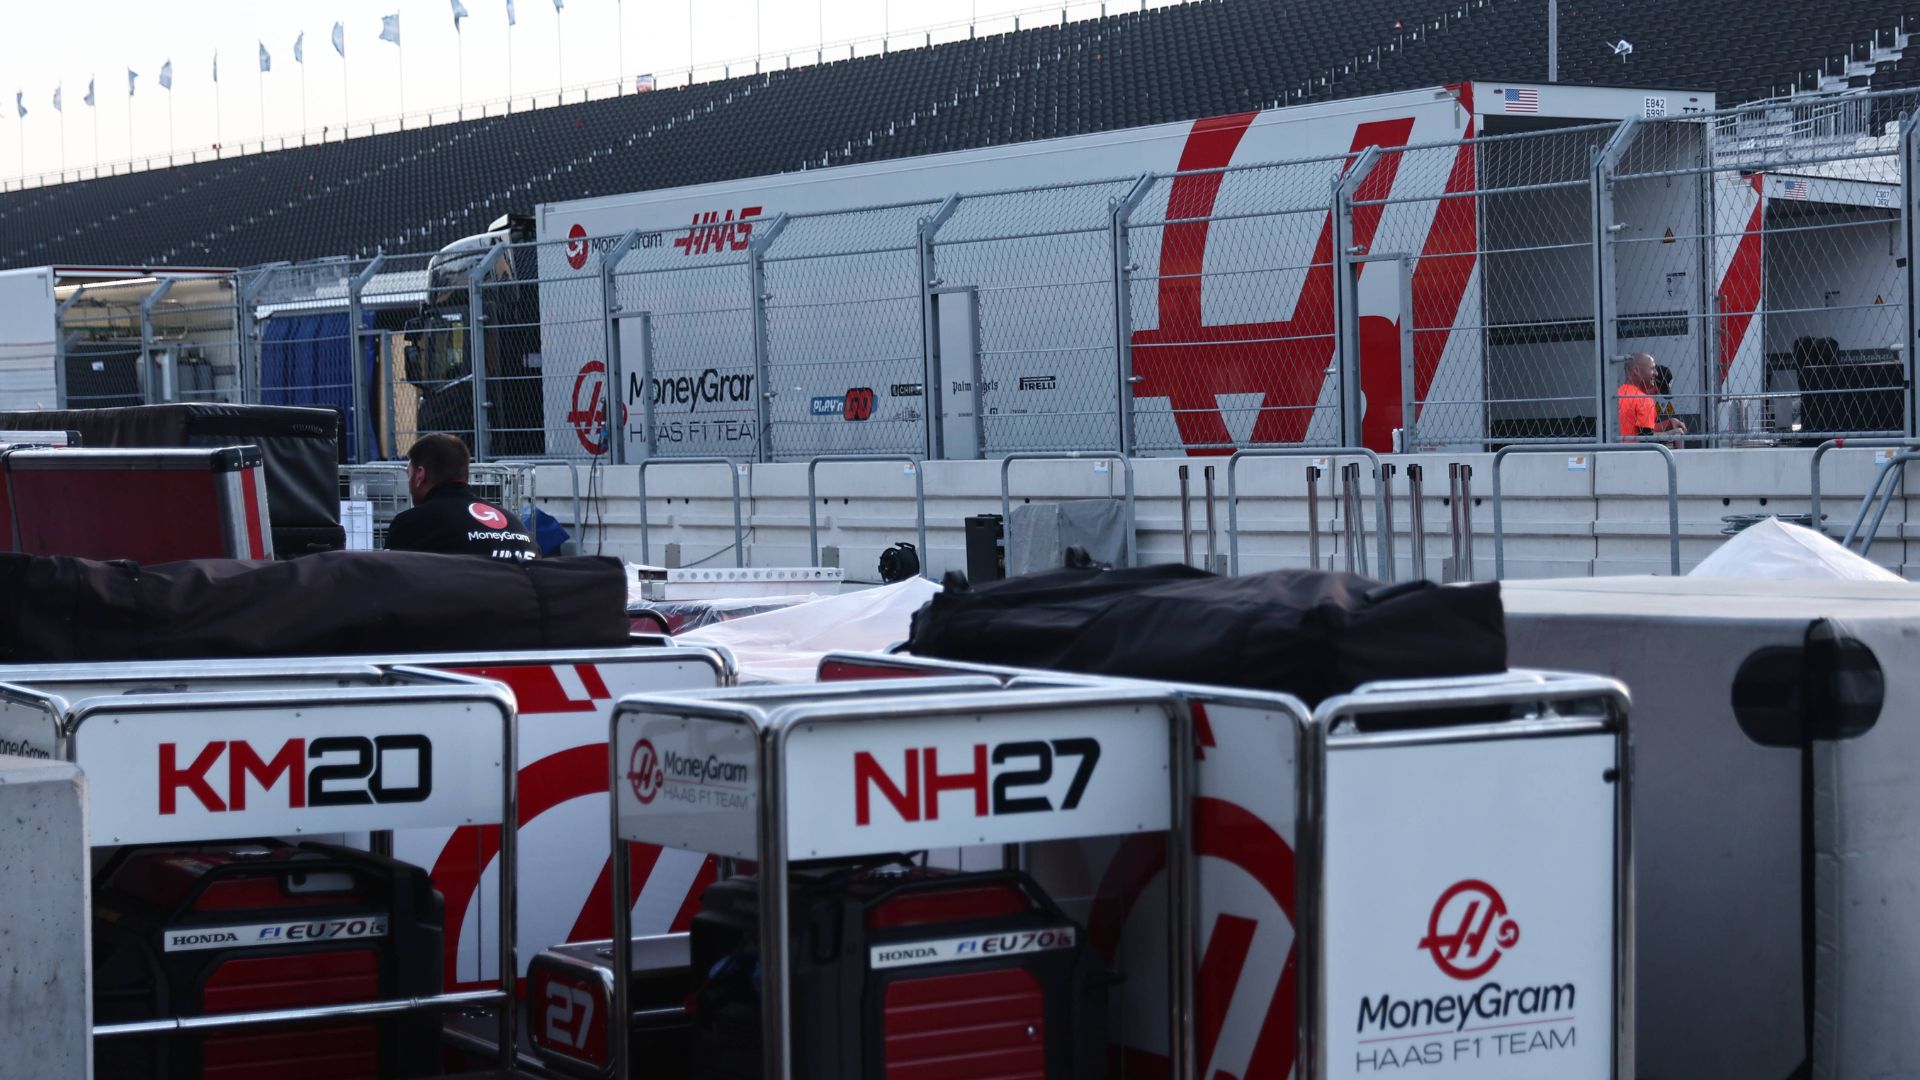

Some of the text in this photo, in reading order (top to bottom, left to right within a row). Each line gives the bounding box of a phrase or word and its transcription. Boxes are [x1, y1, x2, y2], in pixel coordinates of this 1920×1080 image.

[629, 368, 754, 413] MoneyGra
[1019, 376, 1056, 391] PIRELLI
[844, 387, 873, 421] GO
[713, 419, 756, 441] TEA
[352, 484, 366, 497] 14
[468, 530, 531, 543] MoneyGram
[159, 734, 432, 815] KM20
[664, 751, 747, 784] MoneyGram
[854, 737, 1101, 826] NH27
[663, 785, 748, 809] HAAS F1 TEAM
[172, 932, 239, 946] HONDA
[878, 947, 938, 962] HONDA
[546, 981, 594, 1049] 27
[1356, 982, 1576, 1033] MoneyGram
[1356, 1026, 1576, 1073] HAAS F1 TEAM
